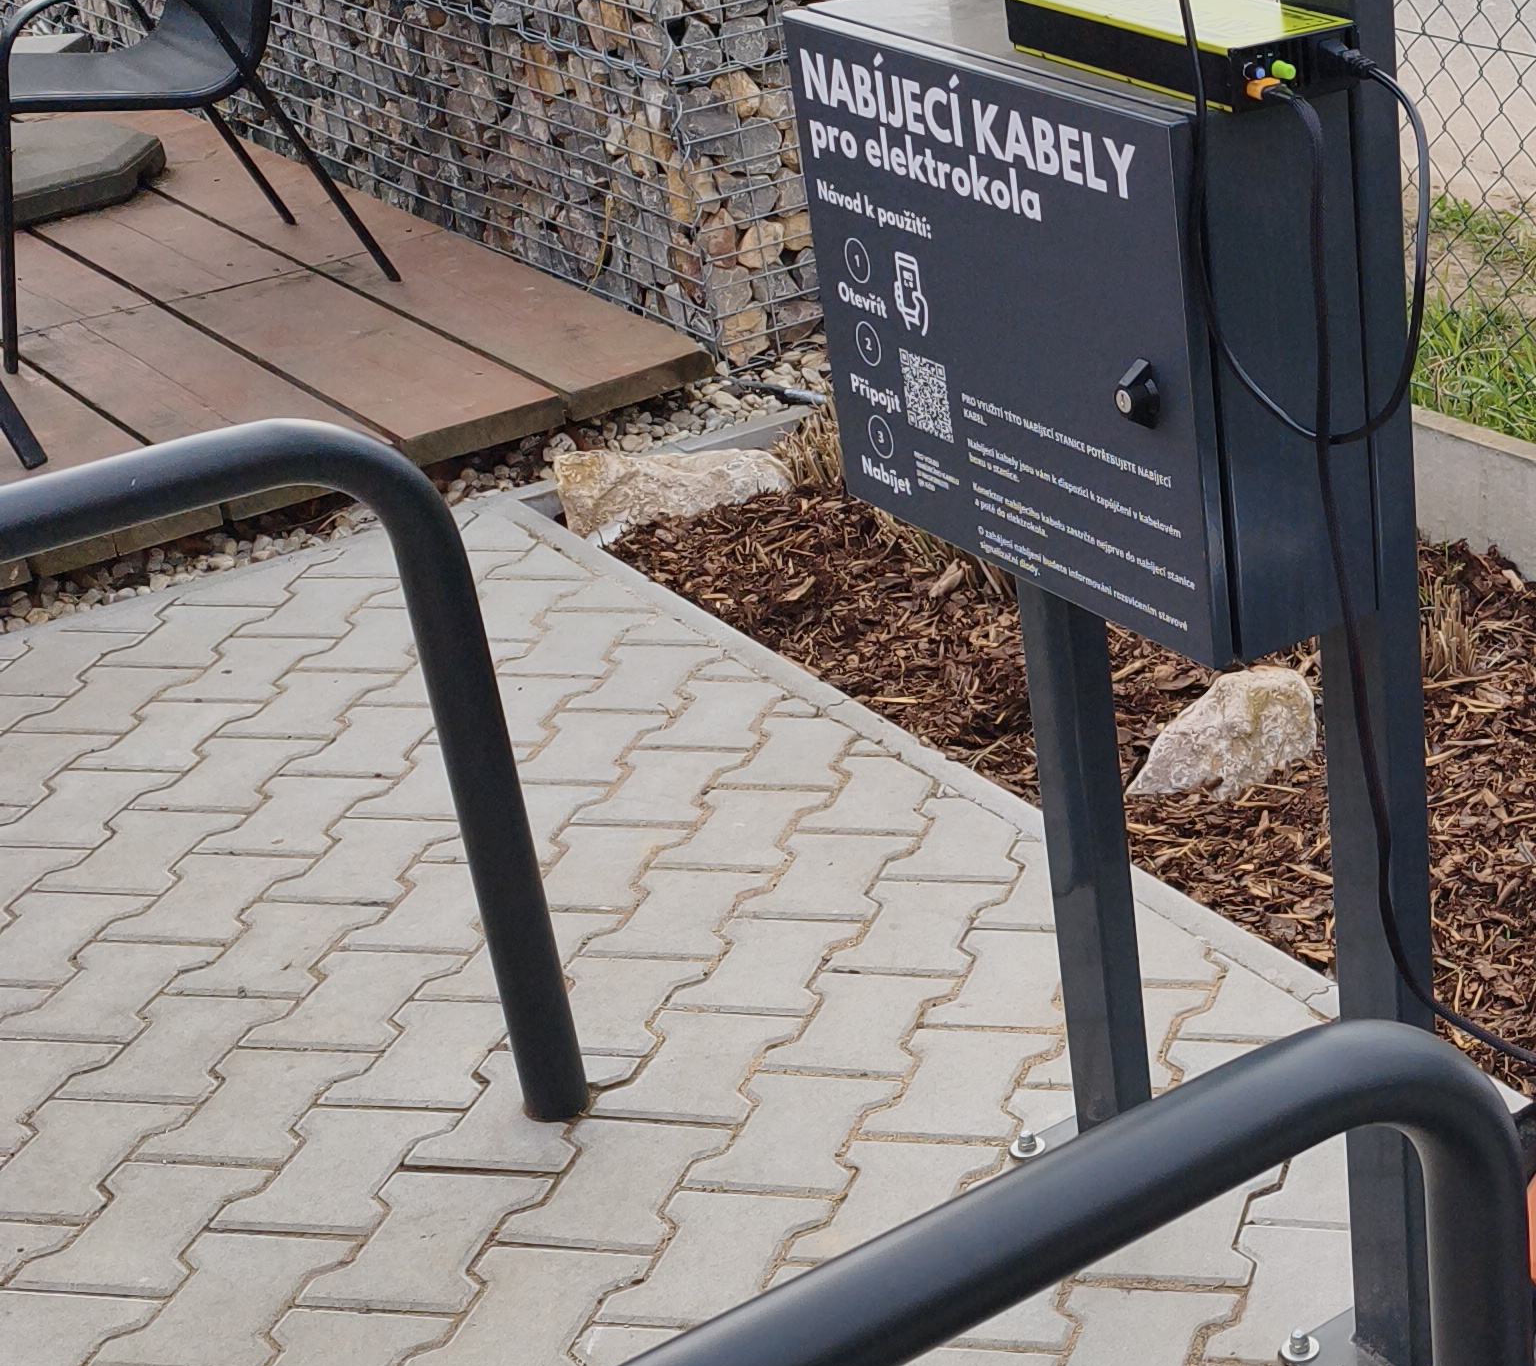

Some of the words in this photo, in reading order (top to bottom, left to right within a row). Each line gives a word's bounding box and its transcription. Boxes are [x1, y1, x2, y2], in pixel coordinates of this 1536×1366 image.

[800, 48, 963, 147] NABÍJECÍ
[971, 99, 1135, 199] KABELY
[809, 120, 858, 159] pro
[865, 125, 1041, 222] elektrokola
[816, 178, 861, 214] Návod
[865, 194, 875, 219] k
[878, 205, 932, 239] použití:
[854, 255, 861, 267] 1
[838, 281, 888, 319] Otevřít
[865, 338, 872, 351] 2
[850, 372, 901, 414] Připojit
[877, 431, 884, 444] 3
[961, 392, 976, 407] PRO
[976, 399, 1003, 419] VYUŽITÍ
[1004, 409, 1022, 426] TÉTO
[1023, 418, 1054, 439] NABÍJECÍ
[1055, 432, 1085, 453] STANICE
[1087, 444, 1136, 474] POTŘEBUJETE
[1138, 465, 1171, 488] NABÍJECÍ
[861, 454, 912, 495] Nabíjet
[995, 450, 1018, 470] kabely
[1019, 460, 1034, 475] jsou
[1035, 469, 1051, 482] vám
[1052, 474, 1057, 485] k
[1090, 490, 1095, 501] k
[1125, 551, 1135, 563] do
